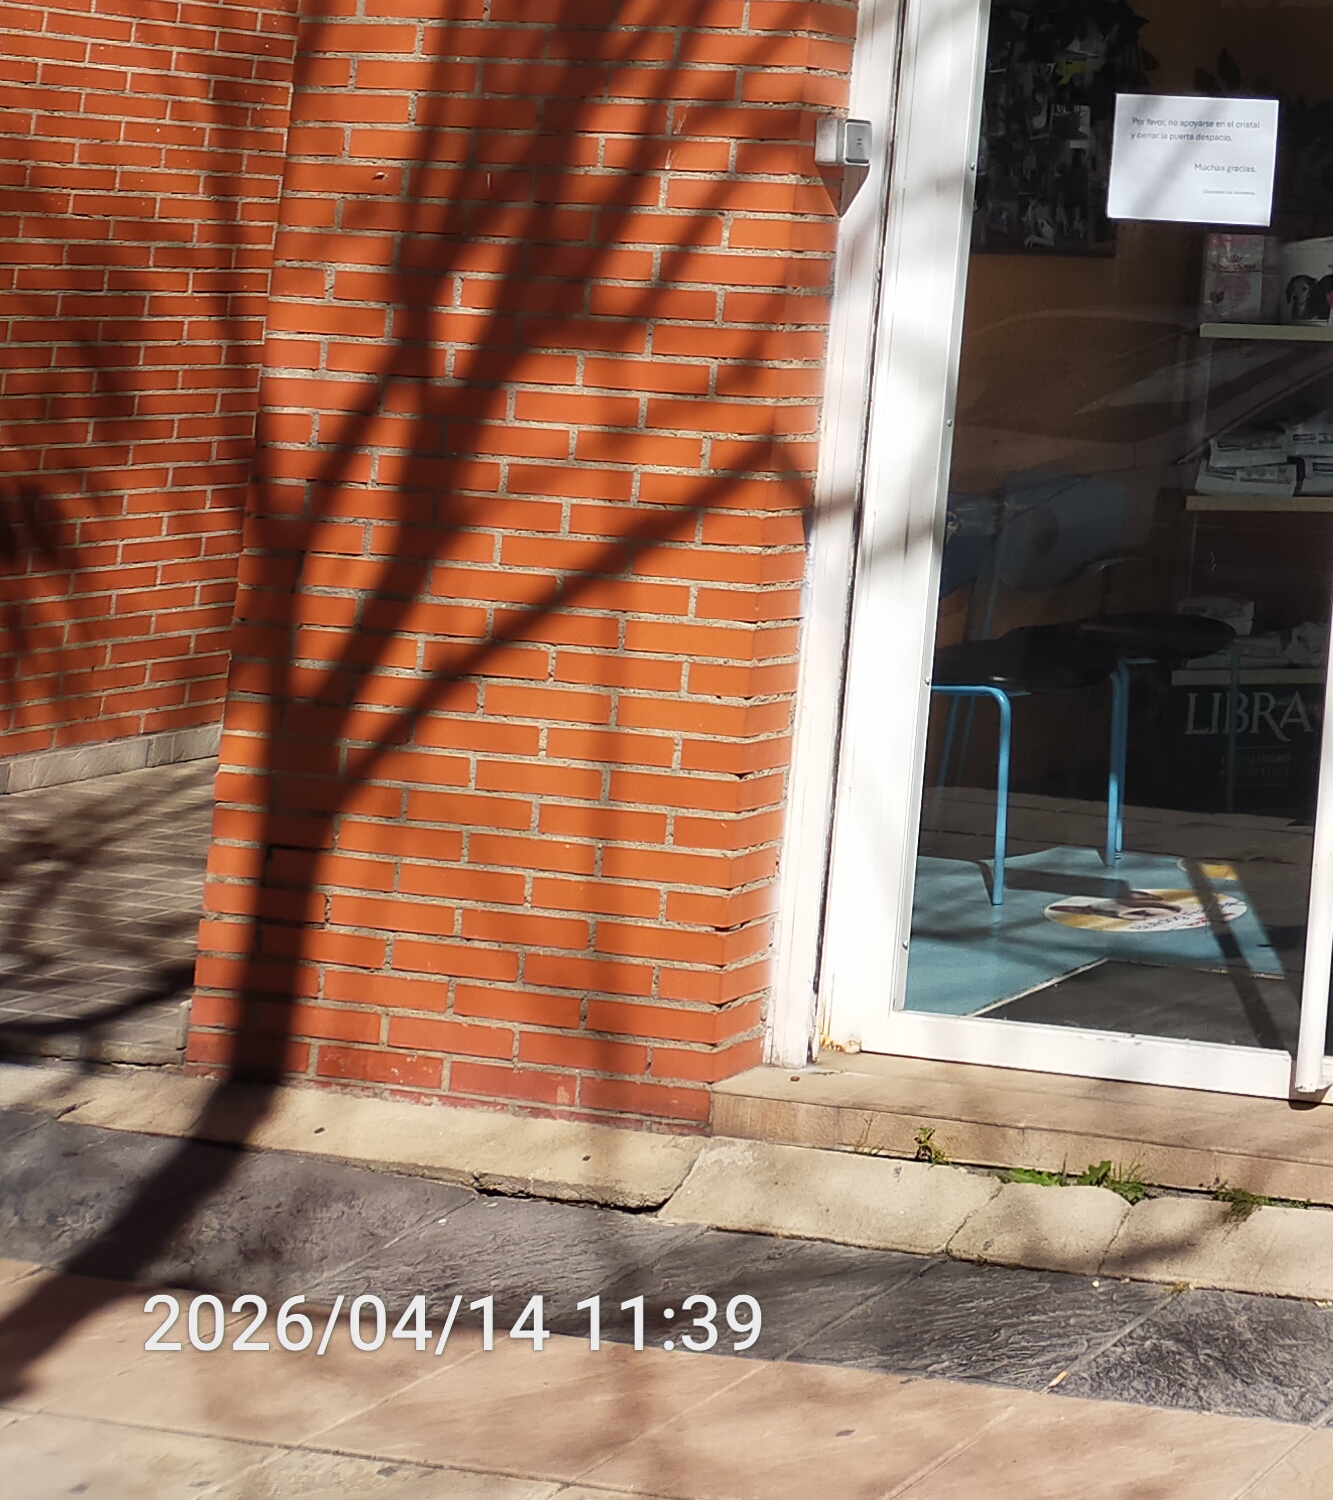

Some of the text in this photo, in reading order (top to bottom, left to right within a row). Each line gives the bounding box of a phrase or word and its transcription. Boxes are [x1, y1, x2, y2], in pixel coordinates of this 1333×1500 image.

[1168, 119, 1178, 127] no
[1179, 119, 1214, 130] apoyarse
[1215, 120, 1226, 128] en
[1226, 119, 1234, 128] el
[1235, 120, 1260, 129] cristal
[1169, 133, 1194, 142] puerta
[1194, 163, 1257, 173] Muchas gracias.
[1184, 690, 1316, 742] LIBRA
